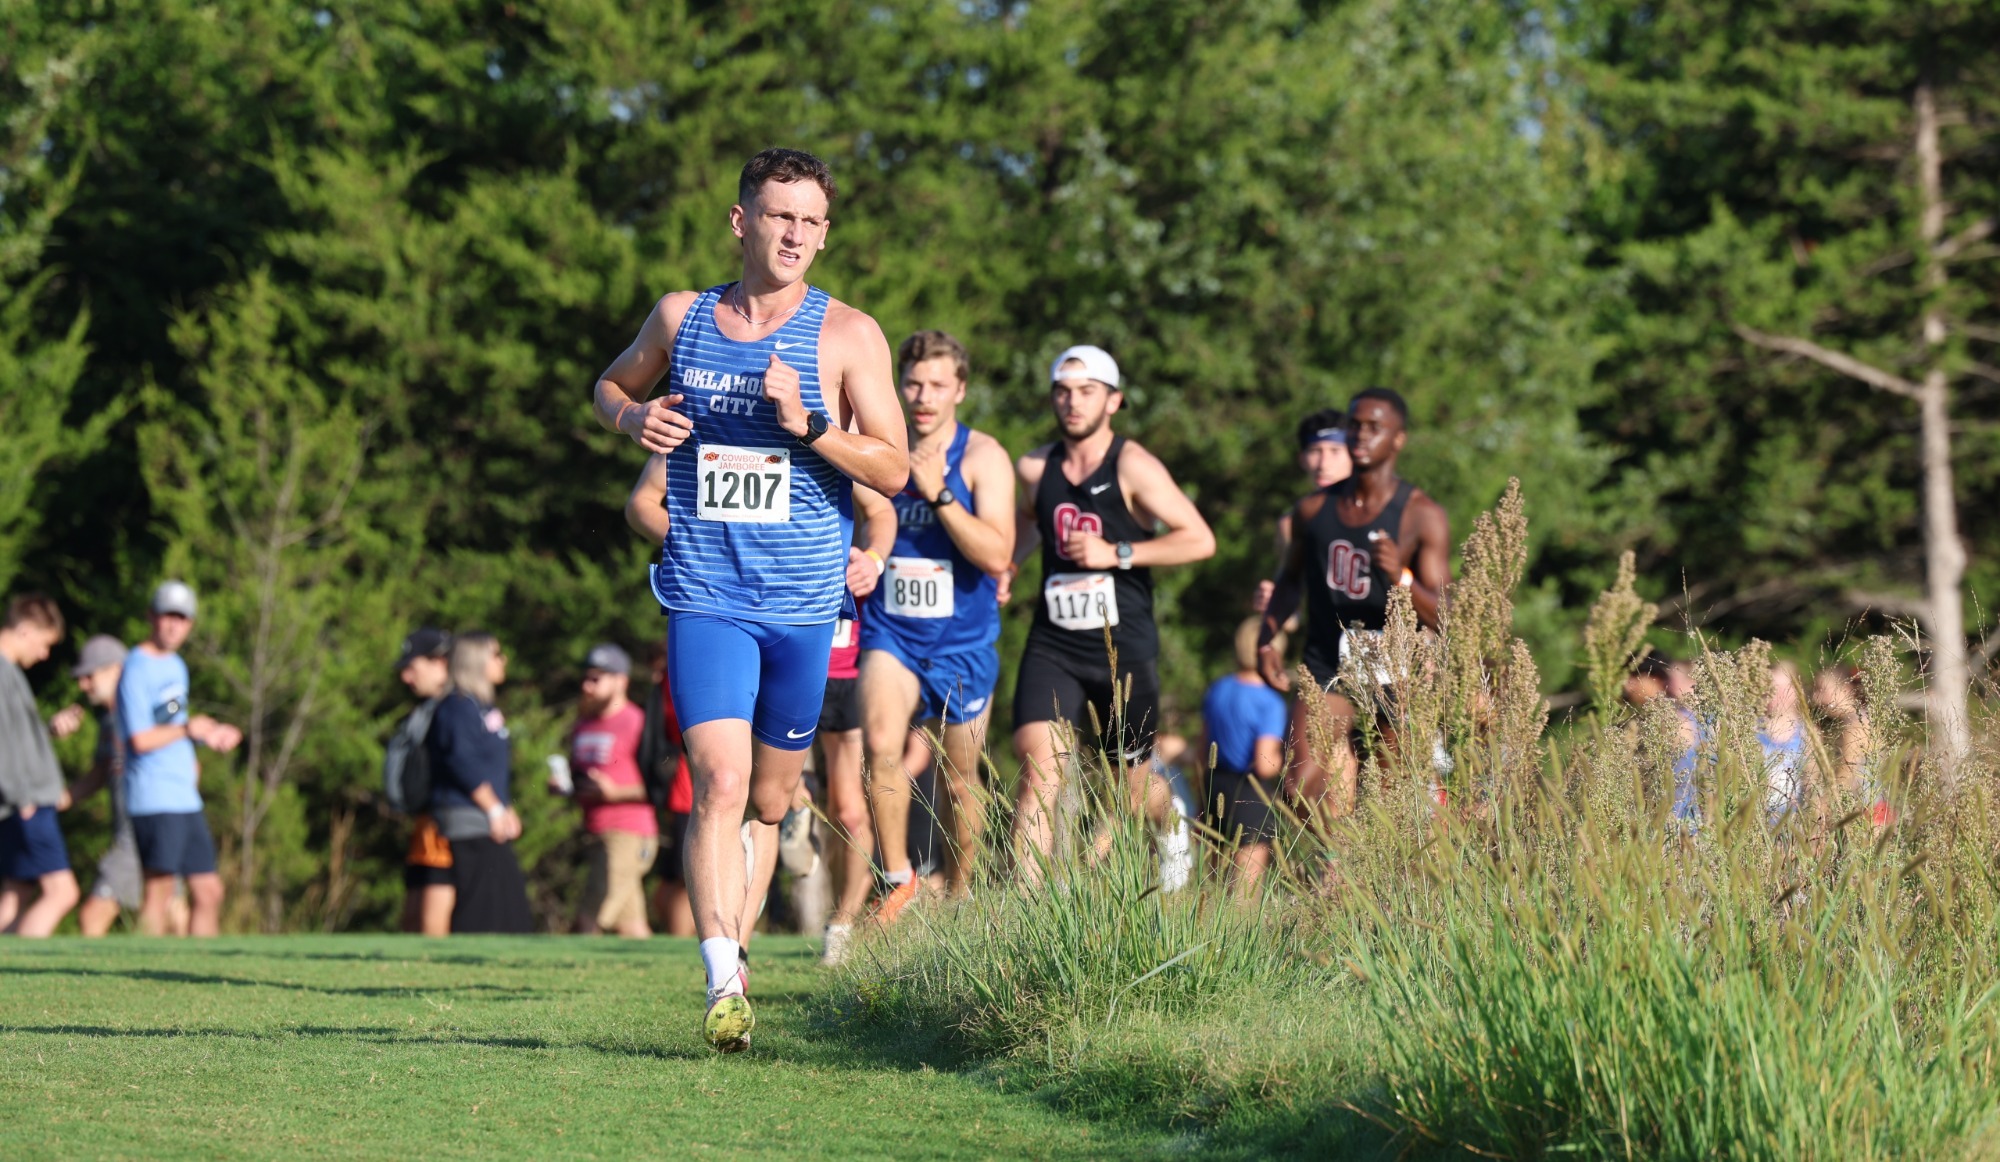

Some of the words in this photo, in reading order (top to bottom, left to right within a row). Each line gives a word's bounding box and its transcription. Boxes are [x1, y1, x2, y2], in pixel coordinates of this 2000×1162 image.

[683, 368, 764, 396] OKLAHO
[709, 394, 757, 416] CITY
[718, 462, 765, 471] JAMBOREE
[721, 453, 762, 463] COWBOY
[704, 470, 782, 510] 1207
[1326, 538, 1371, 600] OC
[895, 578, 937, 607] 890
[1054, 591, 1108, 620] 1178
